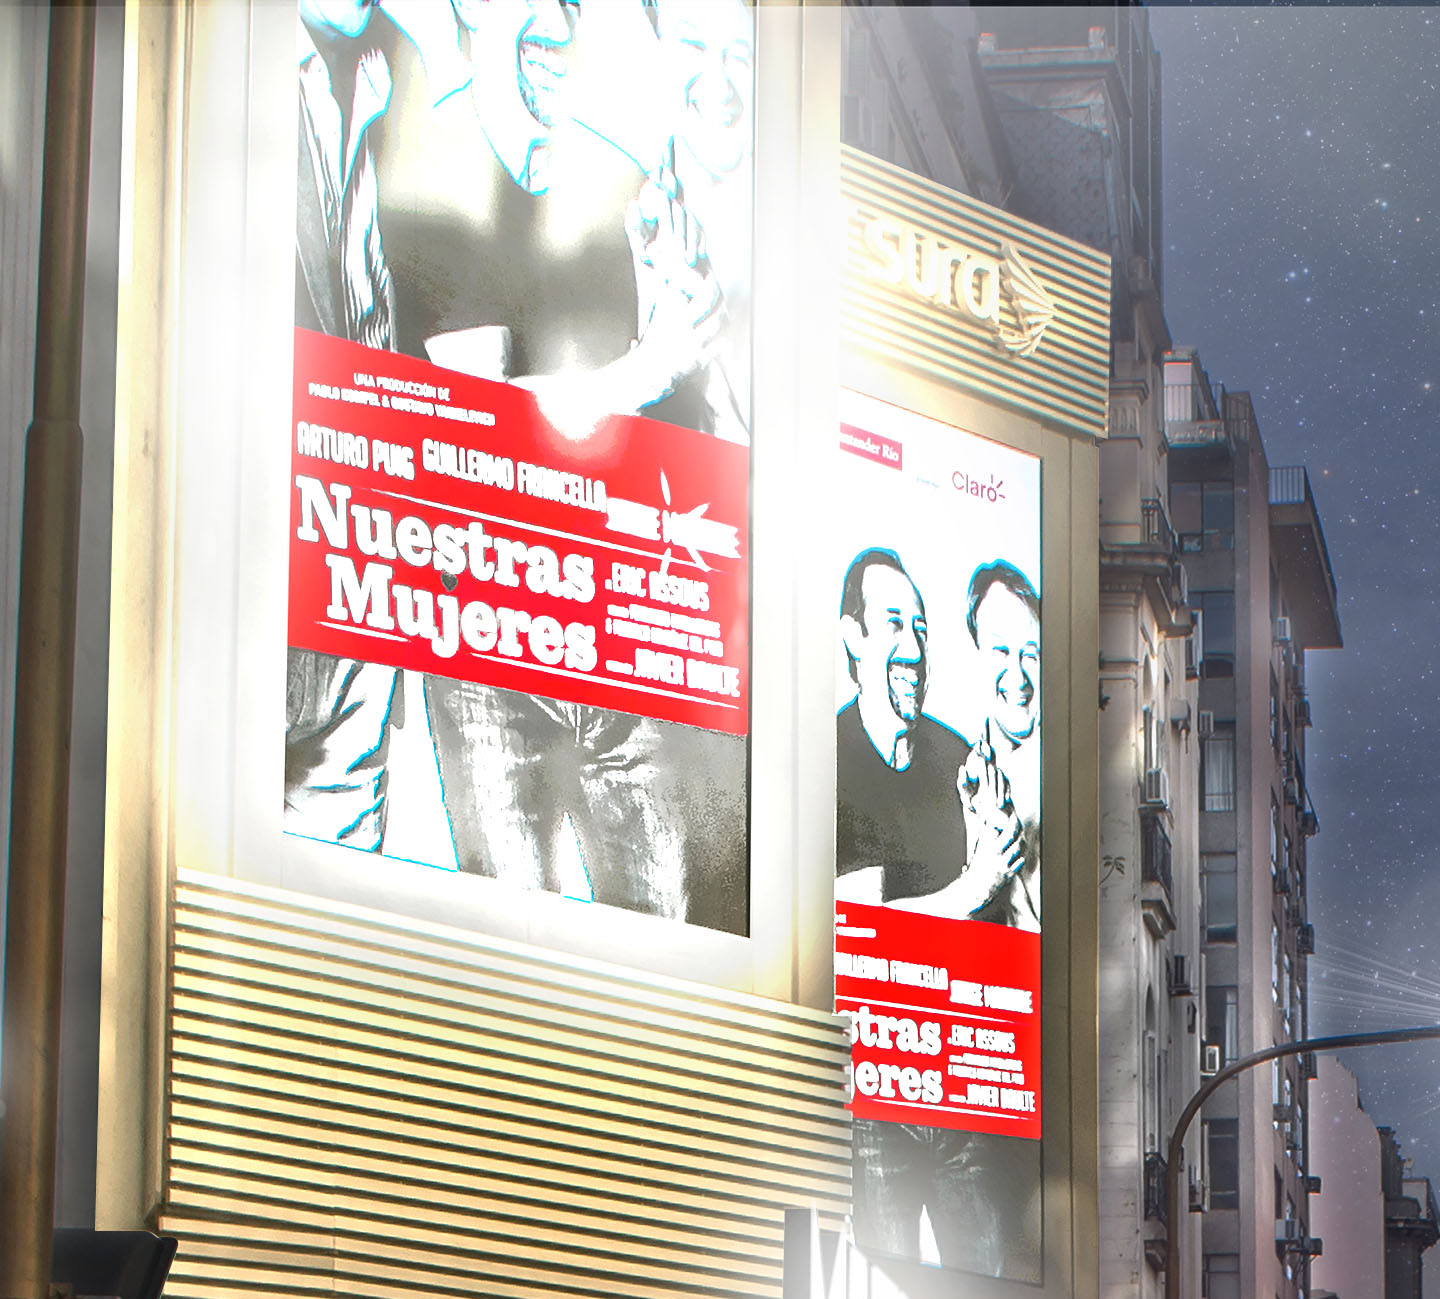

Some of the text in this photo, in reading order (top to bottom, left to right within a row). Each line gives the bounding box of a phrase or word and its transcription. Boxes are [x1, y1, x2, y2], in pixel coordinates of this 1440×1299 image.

[294, 474, 595, 604] Nuestras
[951, 470, 1000, 504] Claro
[325, 552, 598, 674] Mujeres
